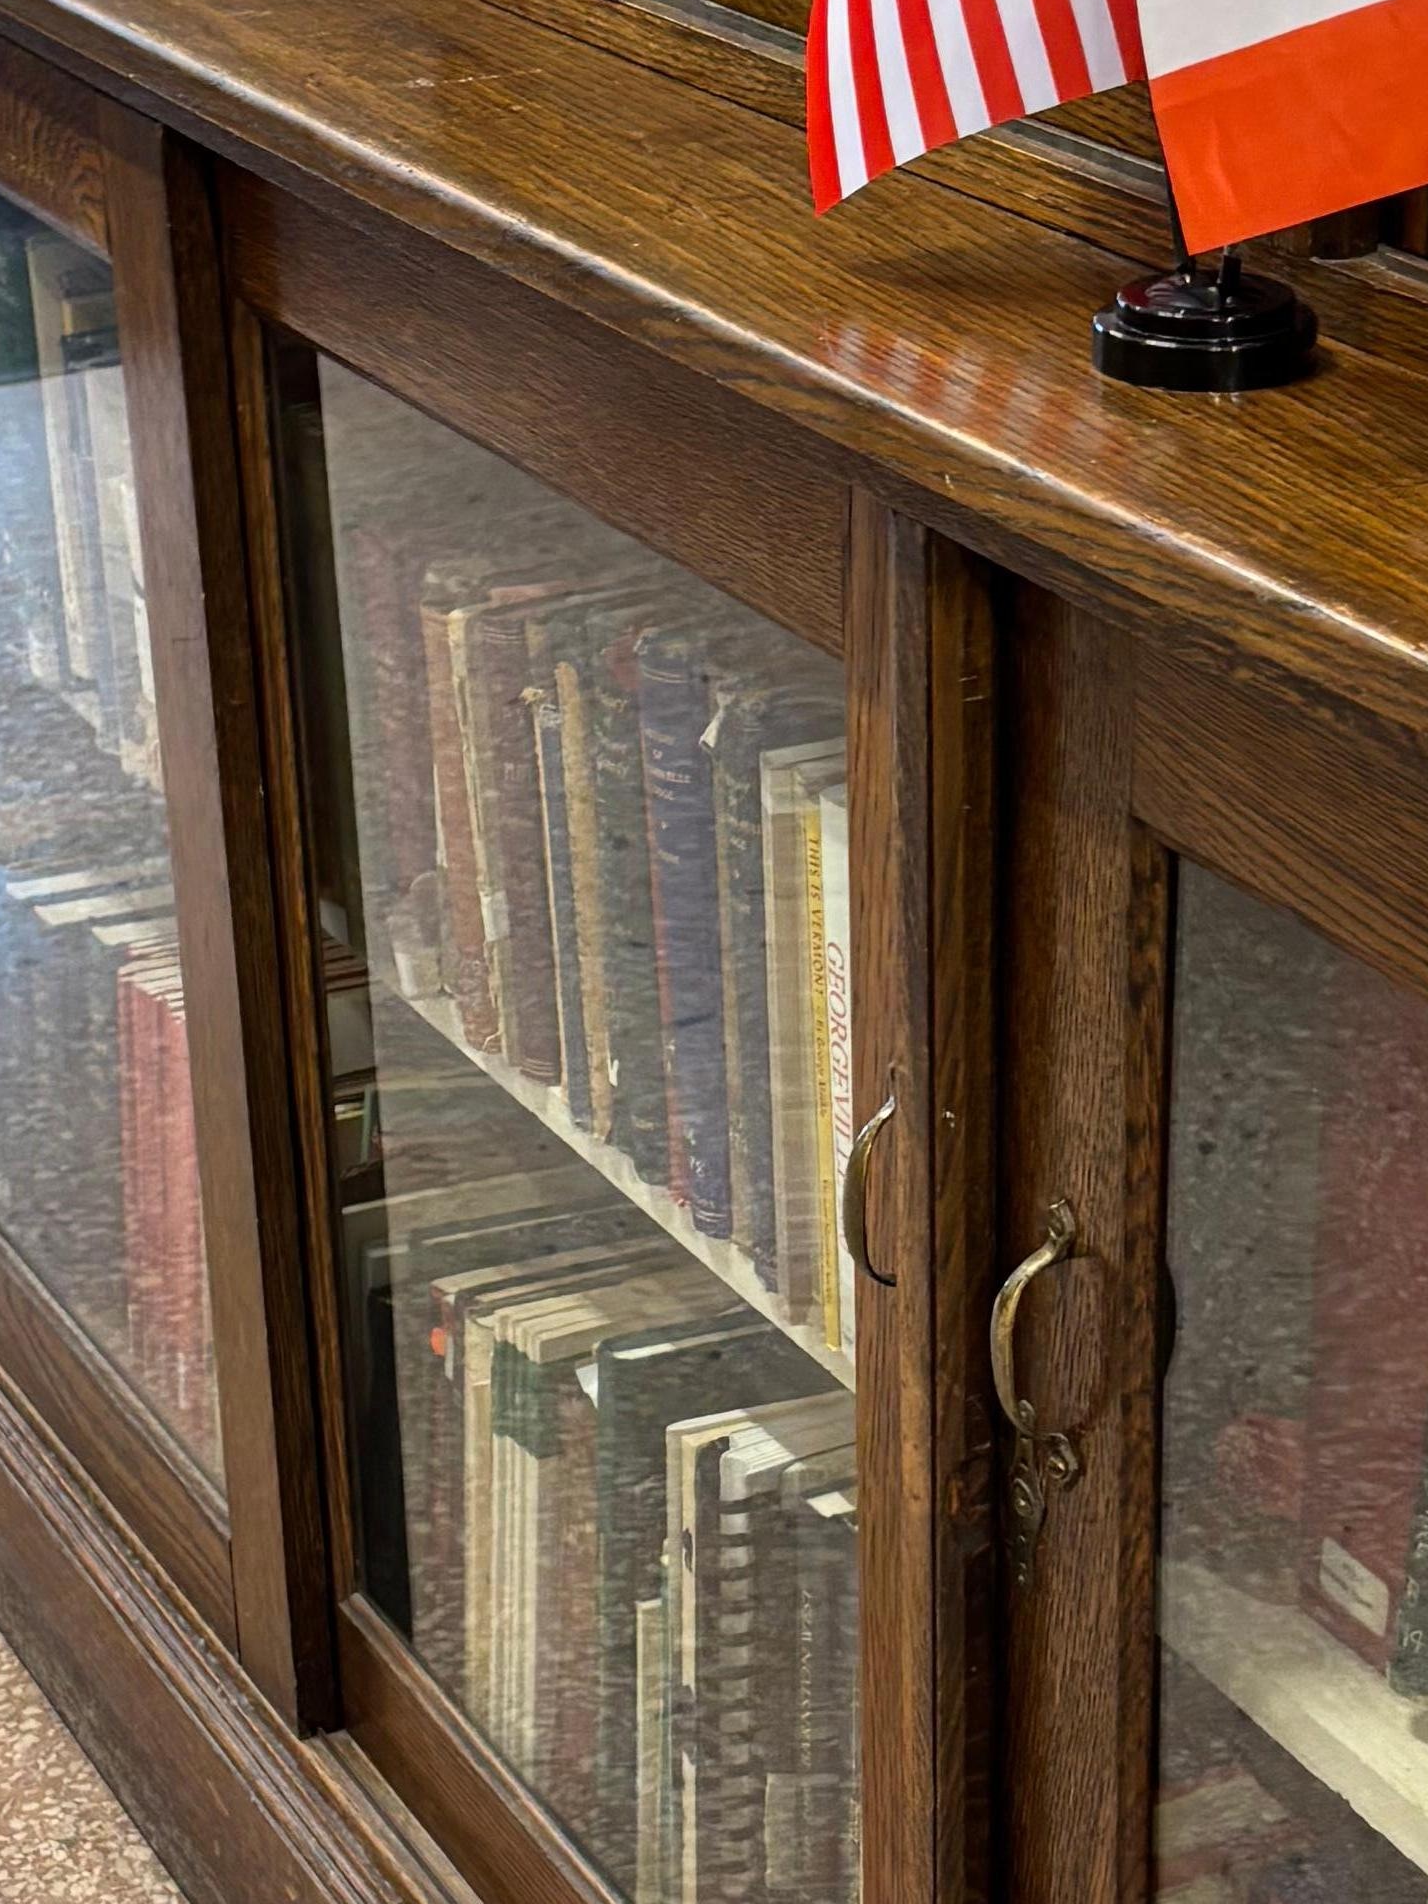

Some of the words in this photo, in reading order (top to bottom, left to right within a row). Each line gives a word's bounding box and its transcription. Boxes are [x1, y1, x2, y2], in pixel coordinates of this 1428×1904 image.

[808, 837, 821, 877] THIS
[810, 883, 822, 900] IS
[811, 908, 824, 998] VERMONT
[826, 941, 853, 1181] GEORGEVILL
